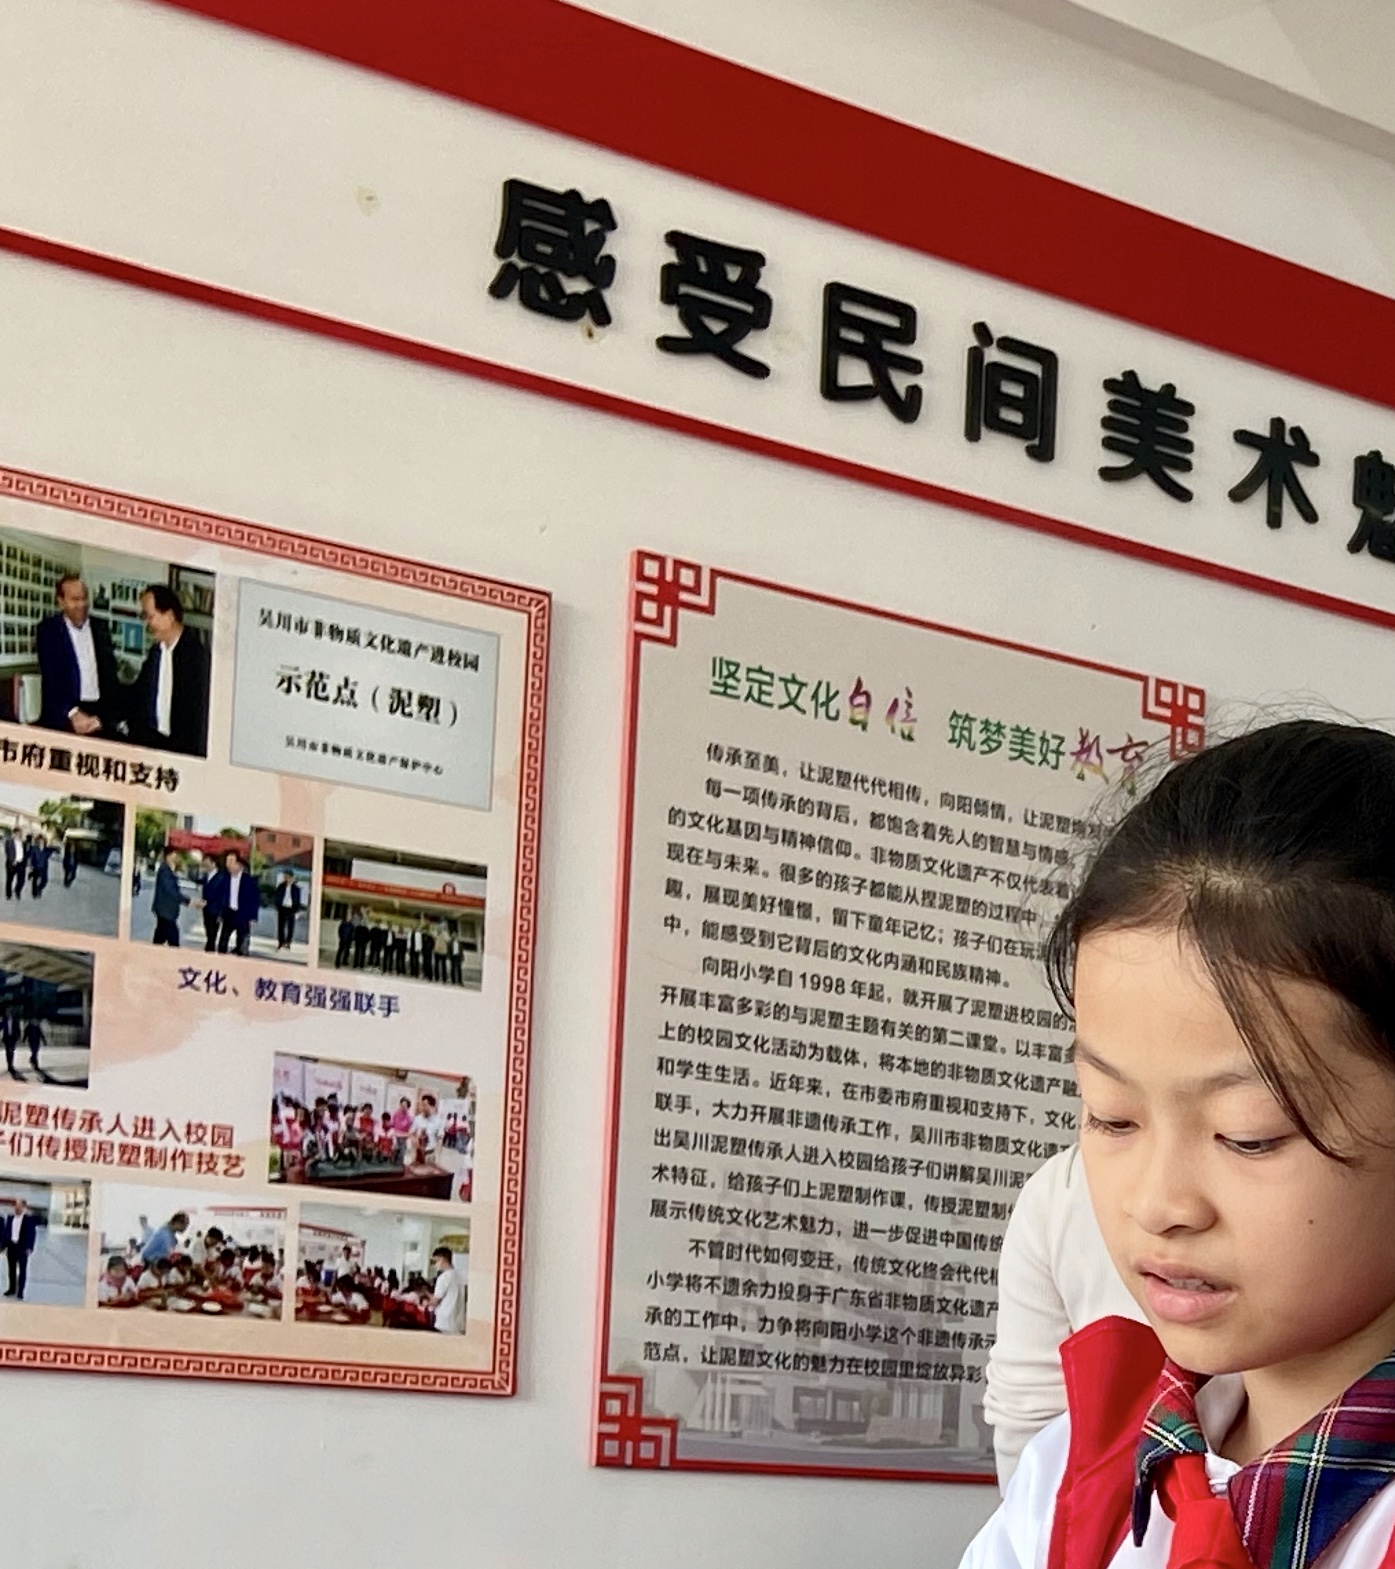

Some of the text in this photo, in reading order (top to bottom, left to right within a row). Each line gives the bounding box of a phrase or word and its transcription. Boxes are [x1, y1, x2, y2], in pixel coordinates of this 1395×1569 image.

[259, 607, 480, 672] 吴川市非物质文化遗产进校园
[178, 967, 400, 1018] 文化、教育强强联手
[658, 1018, 1082, 1099] 上的校园文化活动为载体，将本地的非物质文化遗产融
[653, 1126, 1028, 1189] 出吴川泥塑传承人进入校园给孩子们讲解吴川泥
